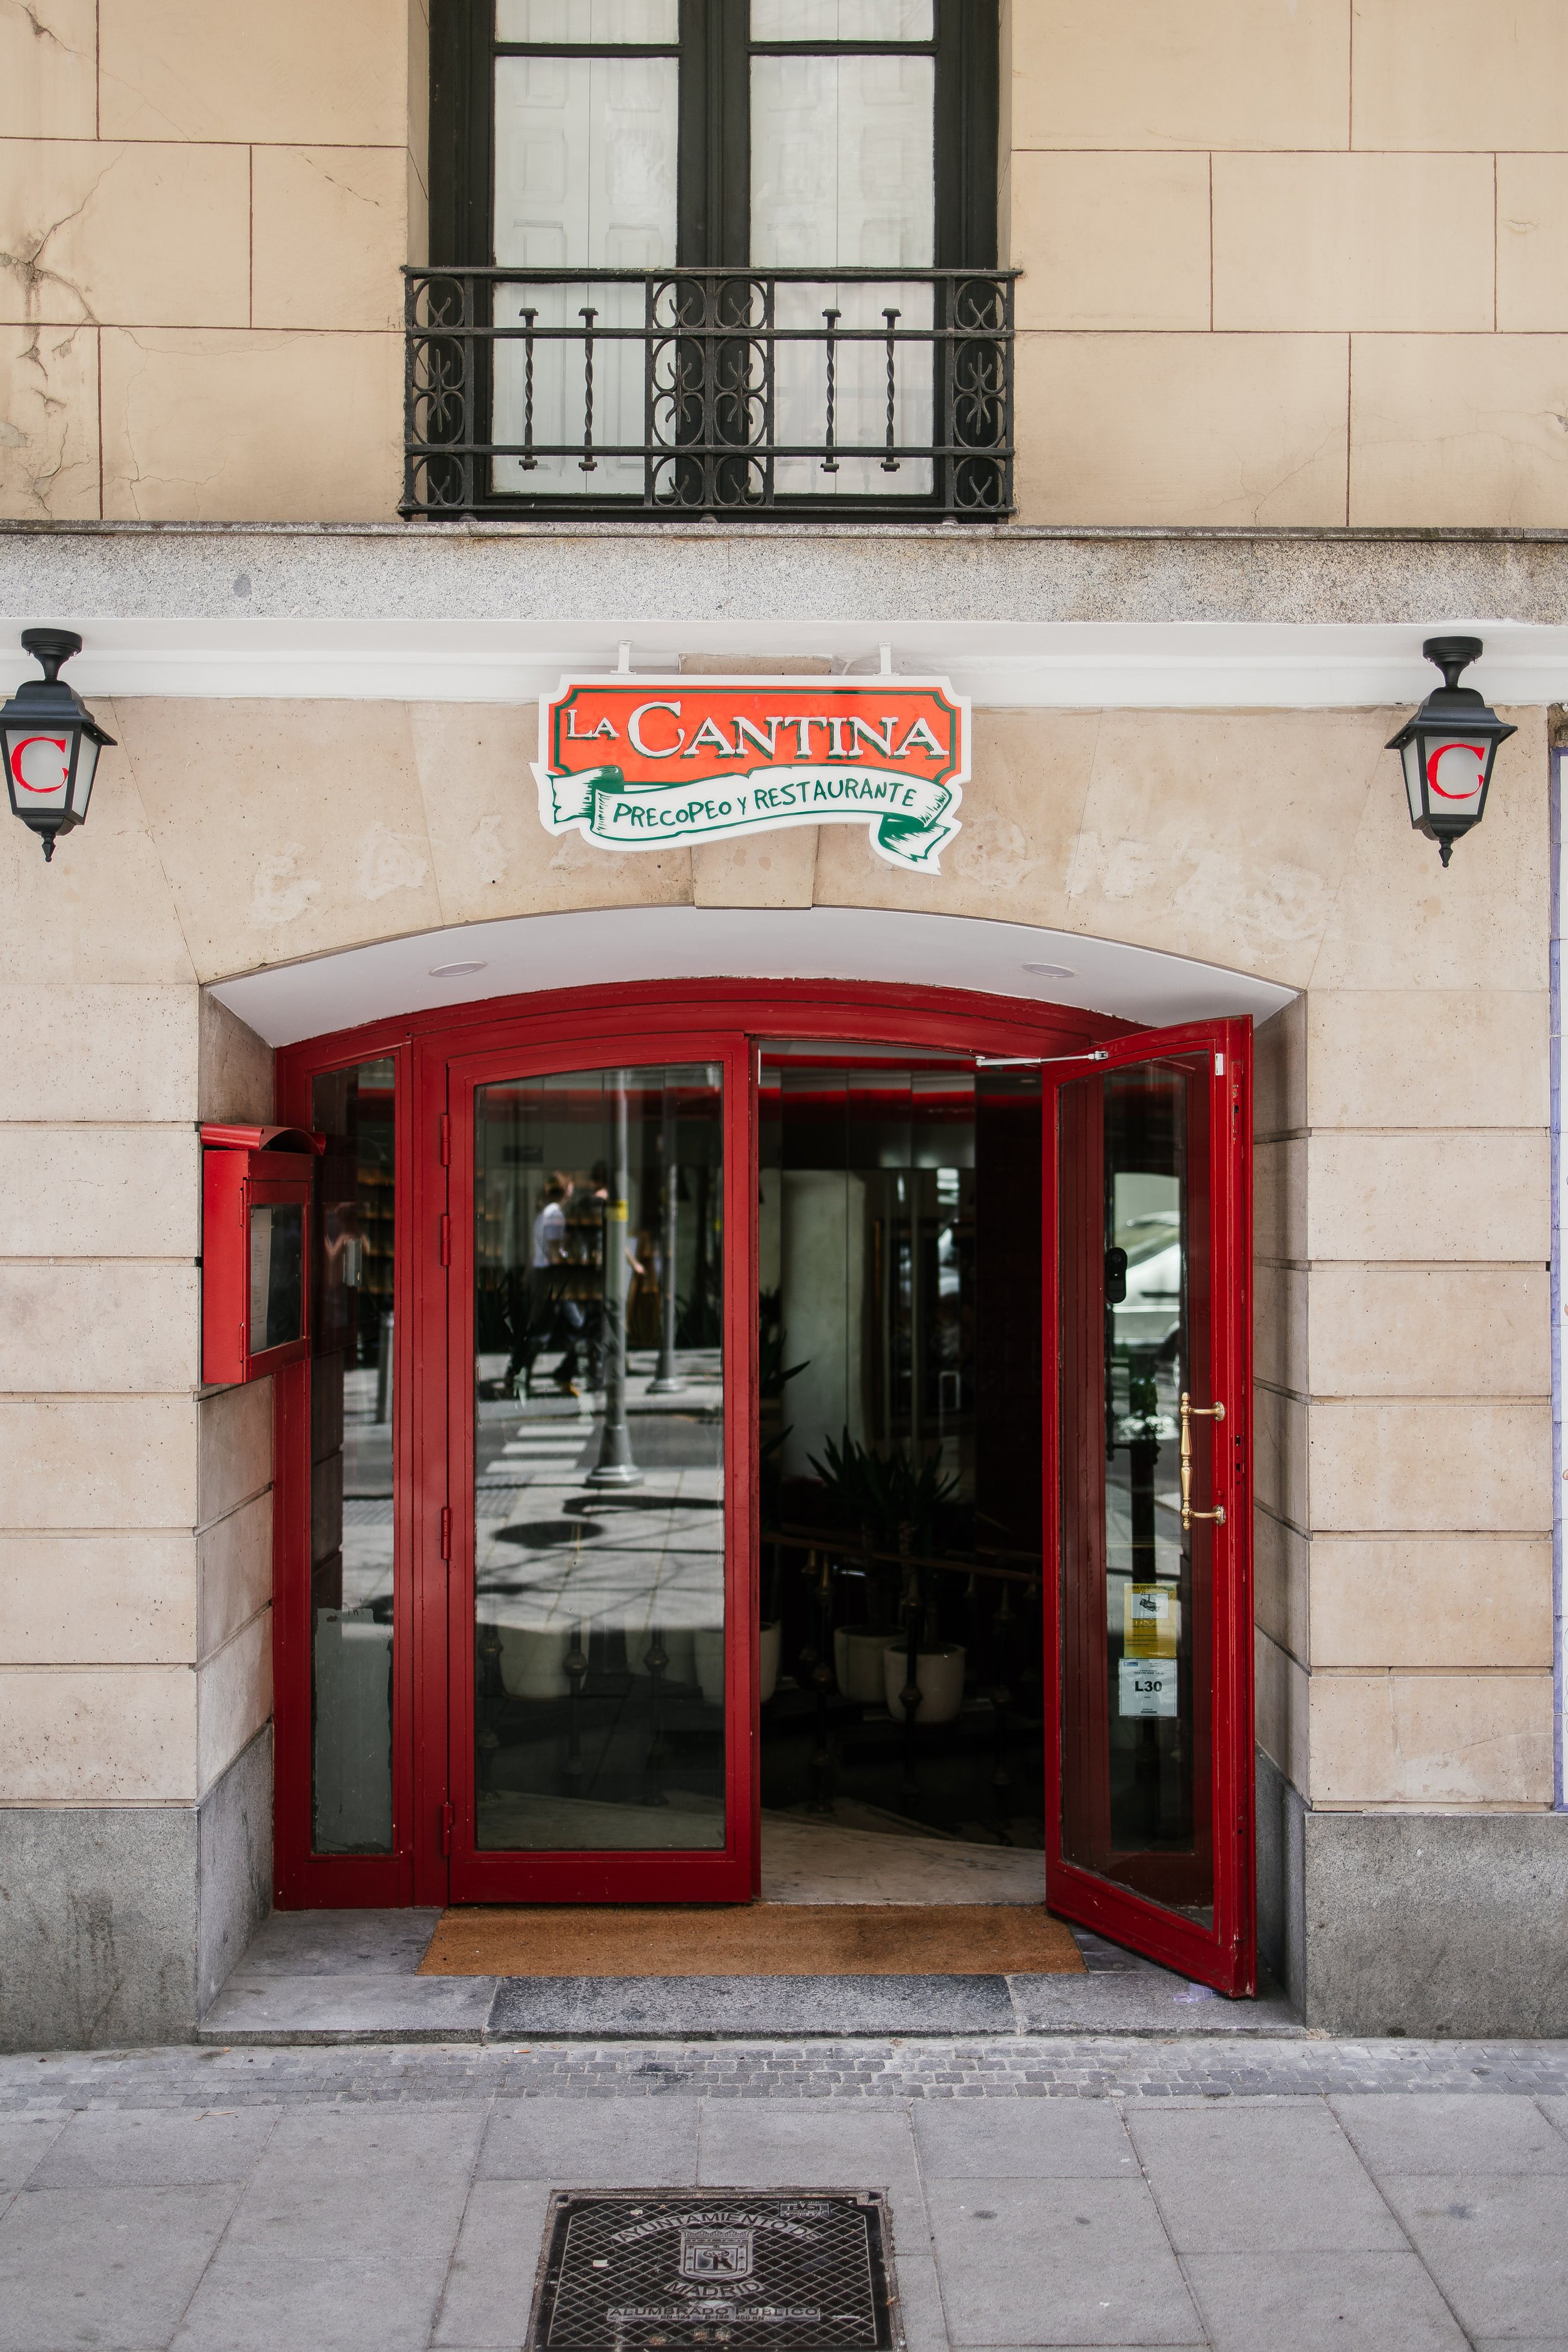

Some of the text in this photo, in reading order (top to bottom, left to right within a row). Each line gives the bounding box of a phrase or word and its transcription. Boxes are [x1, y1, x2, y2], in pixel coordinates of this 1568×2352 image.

[566, 701, 950, 760] LA CANTINA
[11, 736, 69, 793] C
[1427, 743, 1485, 800] C
[736, 795, 747, 815] Y
[754, 778, 918, 810] RESTAURANTE
[1135, 1681, 1162, 1692] L30
[620, 2213, 819, 2242] AYUNTAMIENTO DE
[667, 2280, 761, 2296] MADRID
[609, 2307, 729, 2316] ALUMBRADO
